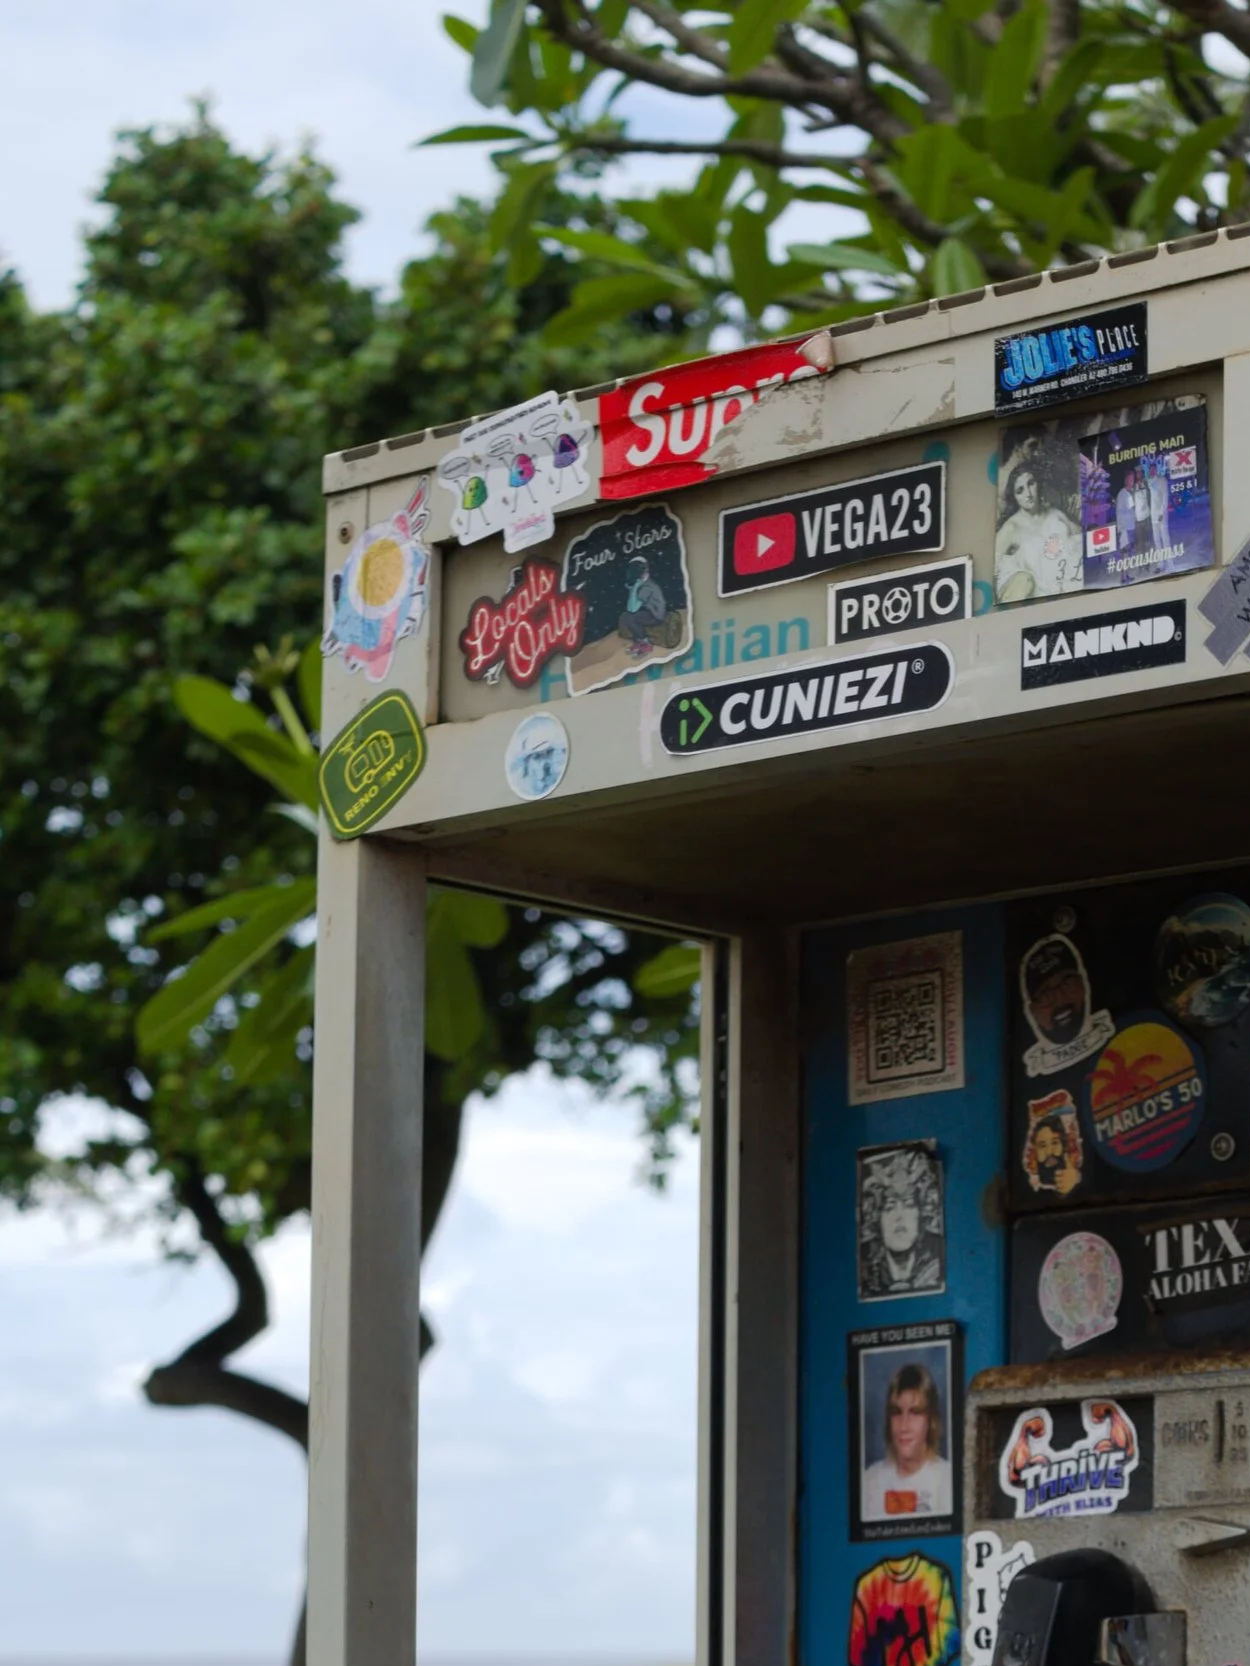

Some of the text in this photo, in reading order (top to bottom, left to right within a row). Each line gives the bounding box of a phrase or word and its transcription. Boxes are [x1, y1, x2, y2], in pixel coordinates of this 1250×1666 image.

[1003, 324, 1139, 388] JOLIE'S PLACE
[1109, 434, 1186, 466] BURNING MAN
[572, 523, 673, 577] Four Stars
[802, 482, 933, 559] VEGA23
[465, 560, 555, 670] Locals
[508, 595, 583, 680] Only
[718, 660, 908, 737] CUNIEZI
[344, 785, 379, 822] RENO
[1095, 1078, 1203, 1142] MARLO'S 50
[1144, 1266, 1228, 1301] ALOHA
[852, 1329, 878, 1346] HAVE
[880, 1327, 904, 1343] YOU
[905, 1325, 933, 1341] SEEN
